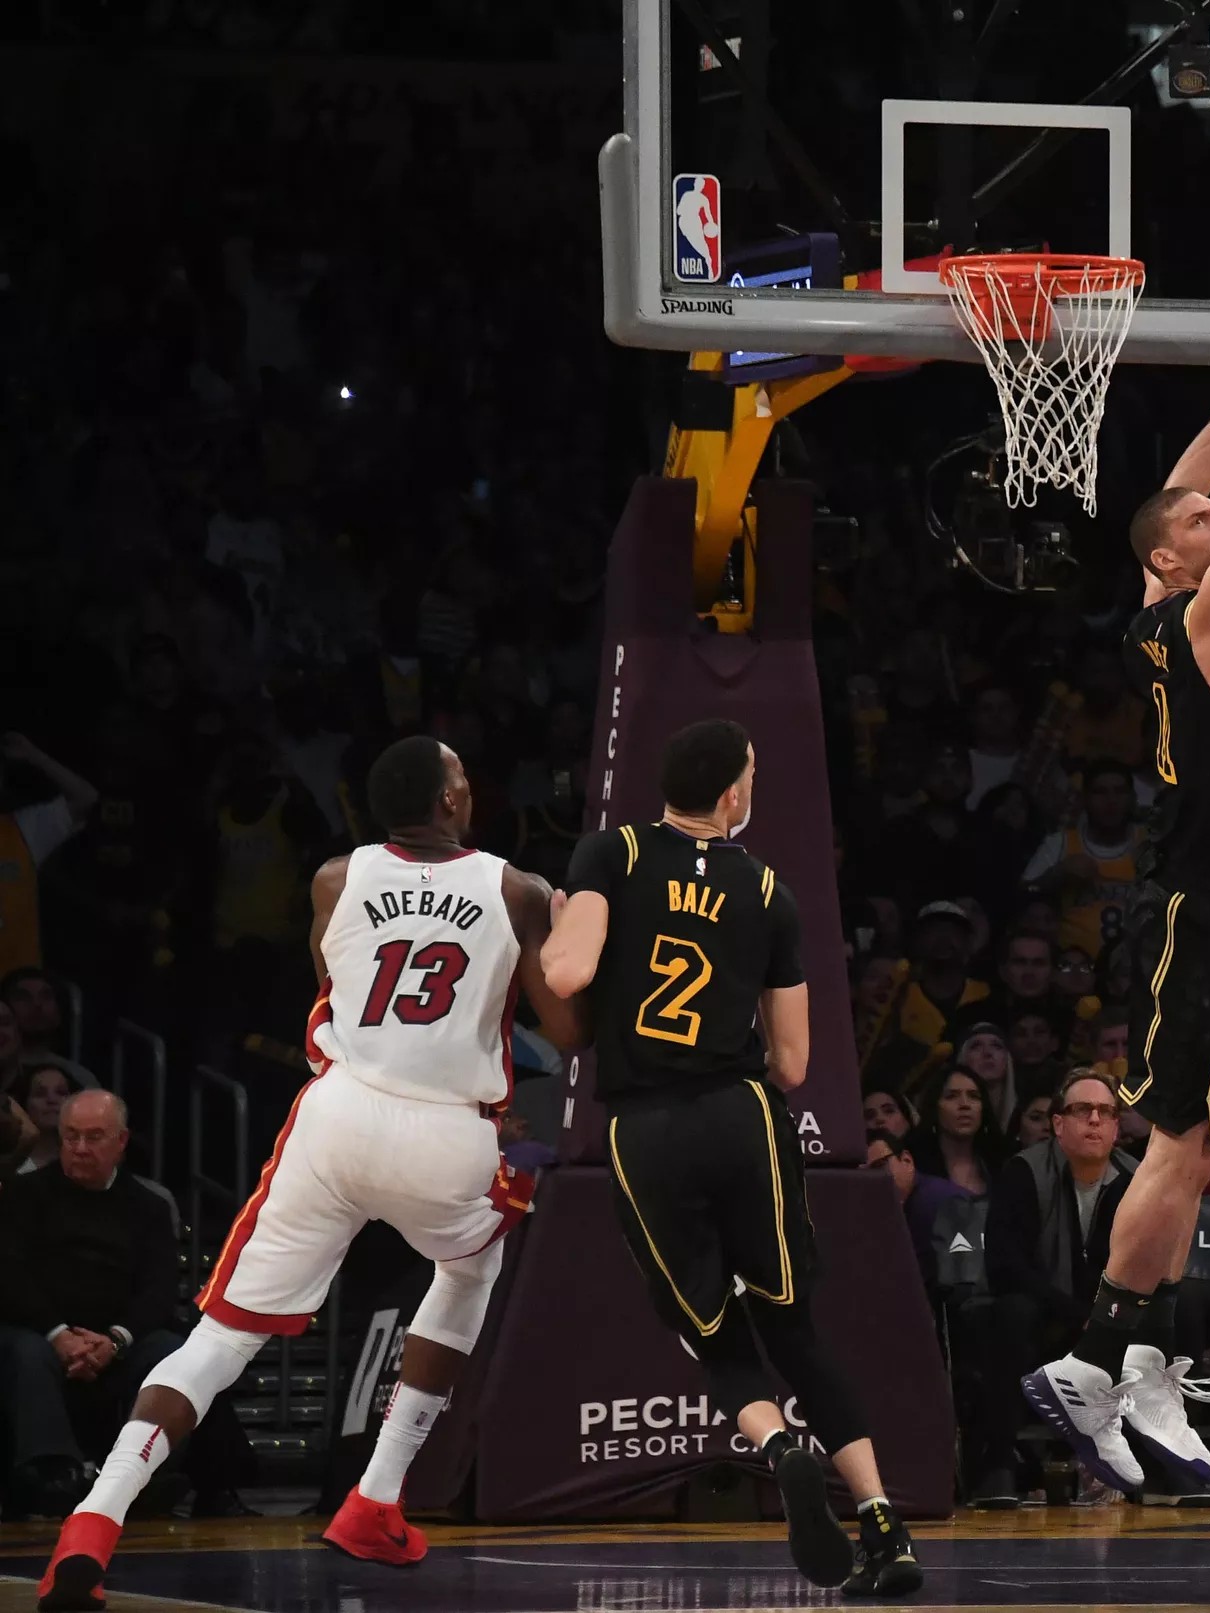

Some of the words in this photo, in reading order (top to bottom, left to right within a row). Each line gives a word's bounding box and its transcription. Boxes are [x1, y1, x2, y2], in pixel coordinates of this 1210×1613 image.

[681, 257, 703, 275] NBA
[661, 298, 734, 316] SPALDING
[363, 891, 483, 930] ADEBAYO
[668, 880, 726, 923] BALL
[358, 939, 471, 1027] 13
[635, 934, 713, 1046] 2
[580, 1434, 709, 1463] RESORT
